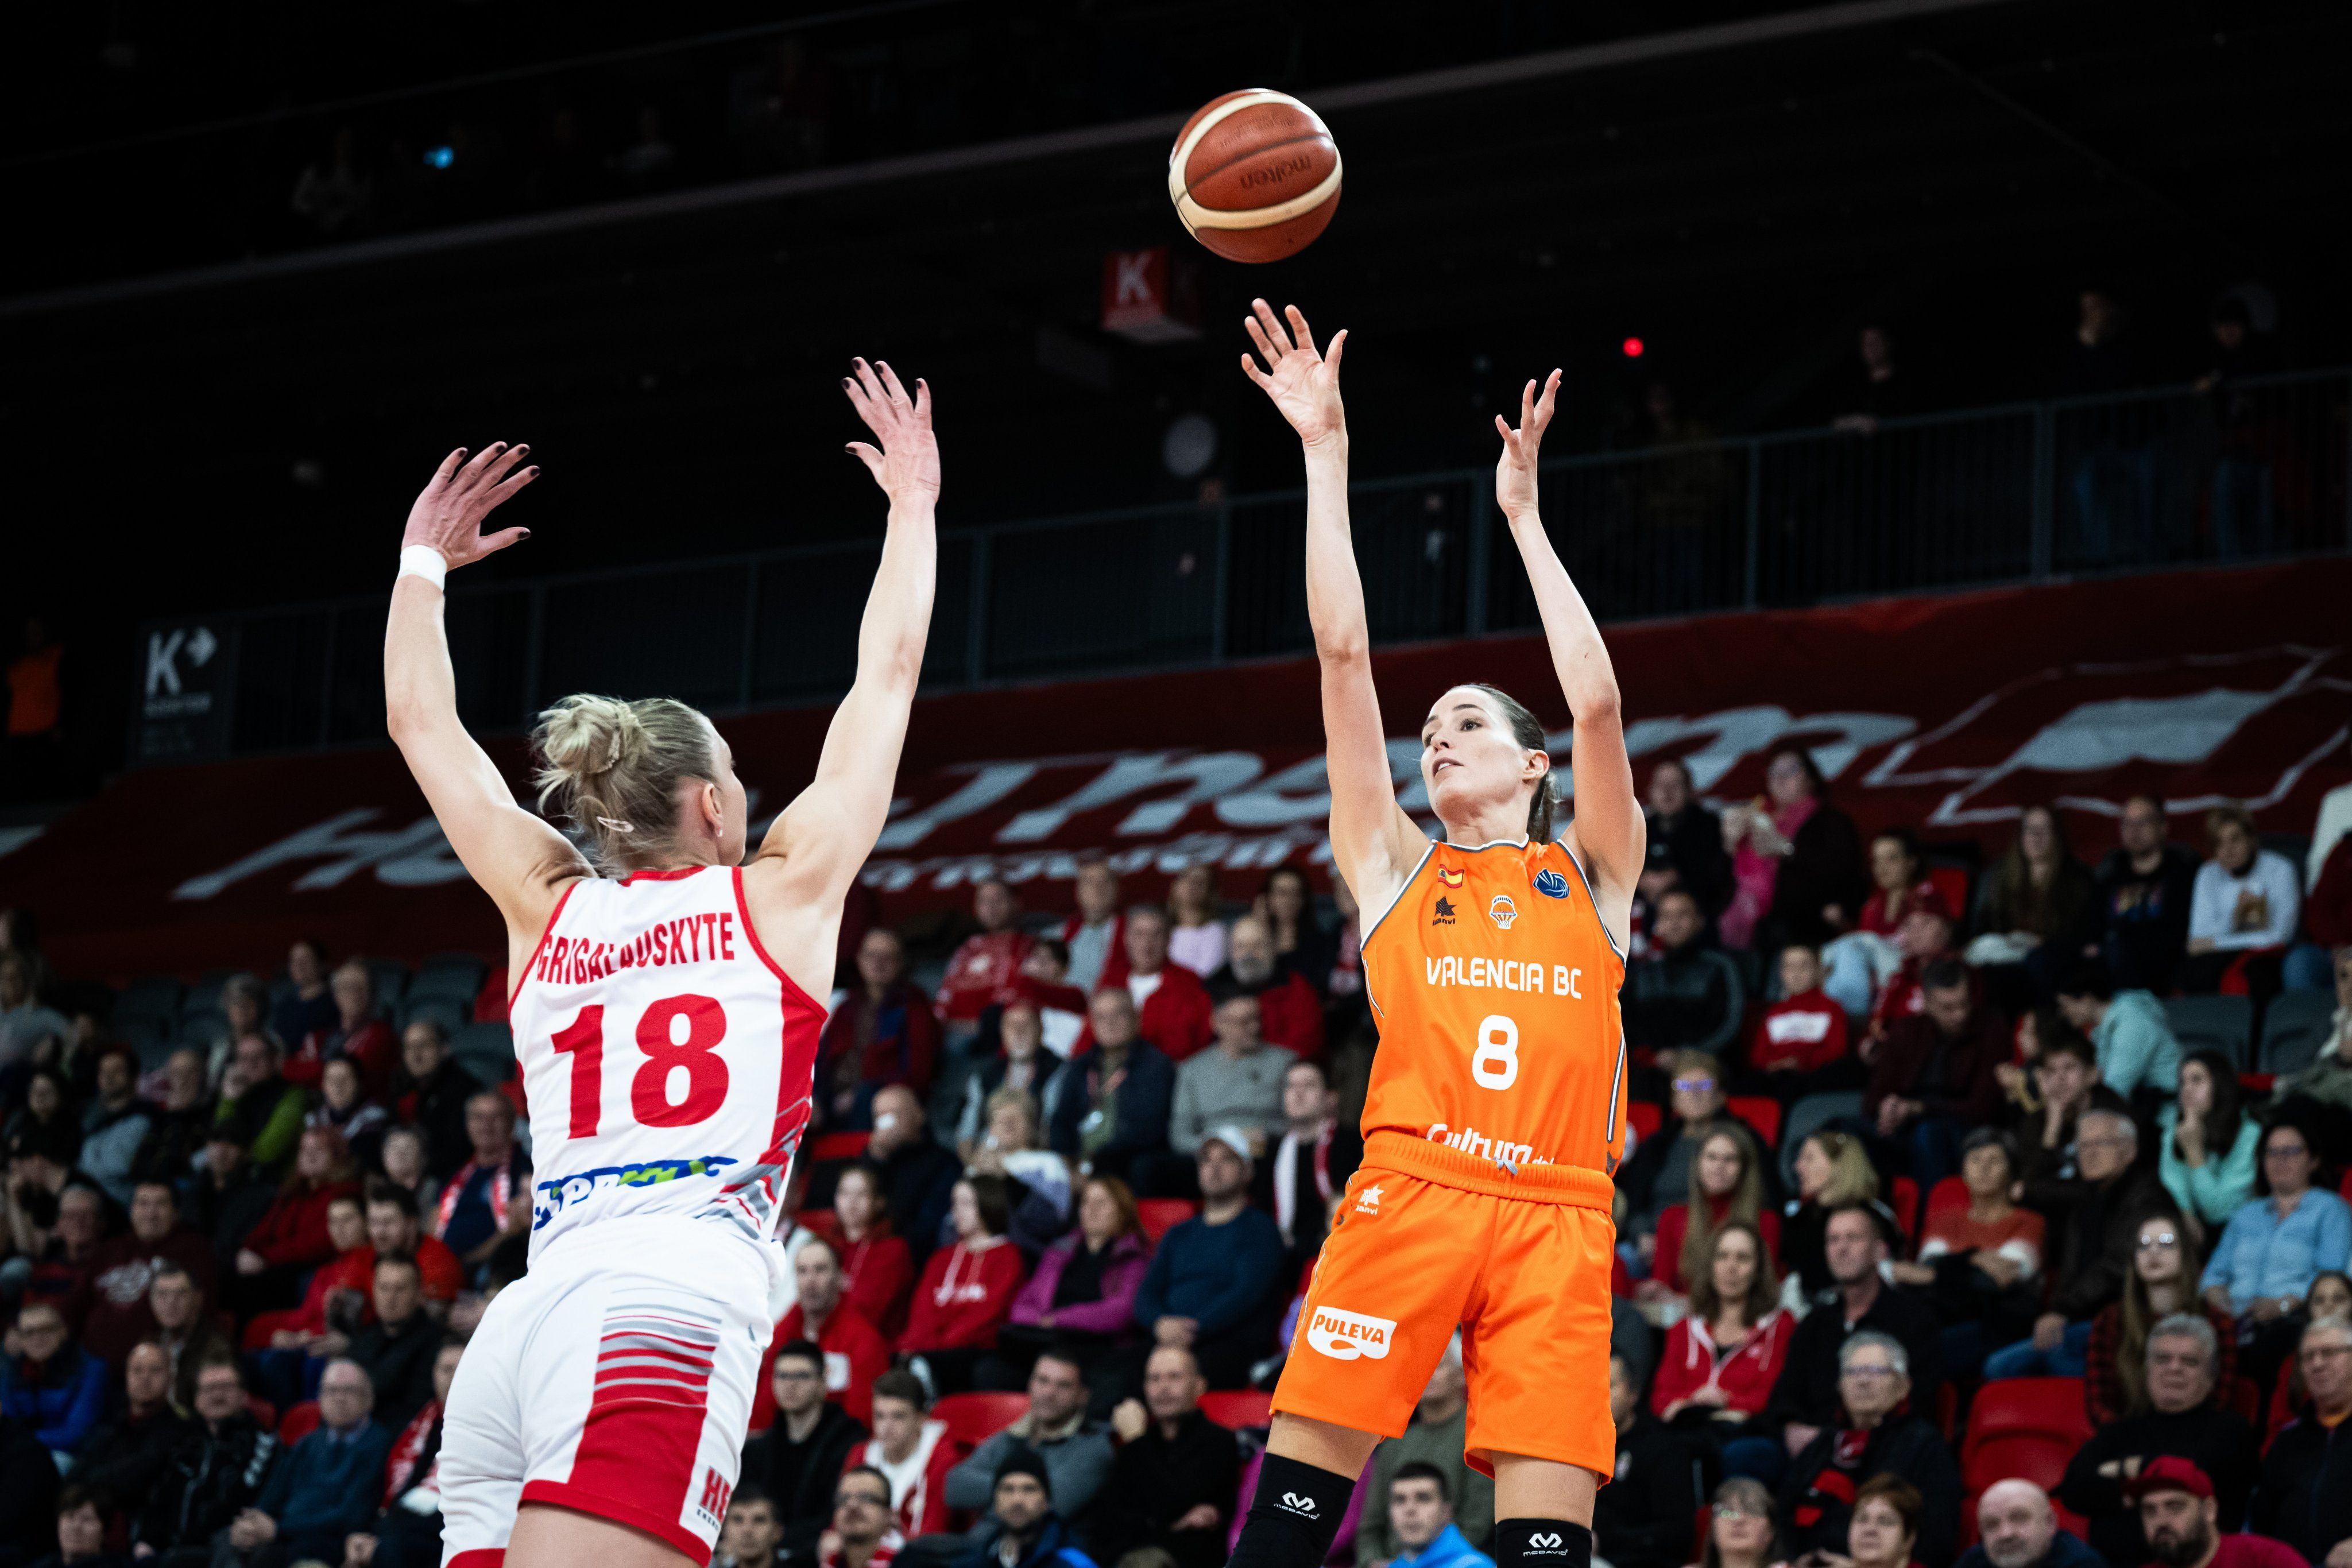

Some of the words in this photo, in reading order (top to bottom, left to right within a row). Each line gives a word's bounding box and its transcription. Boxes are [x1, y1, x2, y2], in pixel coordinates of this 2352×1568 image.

[1240, 156, 1311, 189] molten
[1117, 251, 1153, 304] K
[145, 628, 187, 698] K
[1426, 955, 1544, 993] VALENCIA
[1553, 965, 1581, 1000] BC
[550, 993, 729, 1139] 18
[1472, 1015, 1519, 1090] 8
[1313, 1314, 1384, 1345] PULEVA
